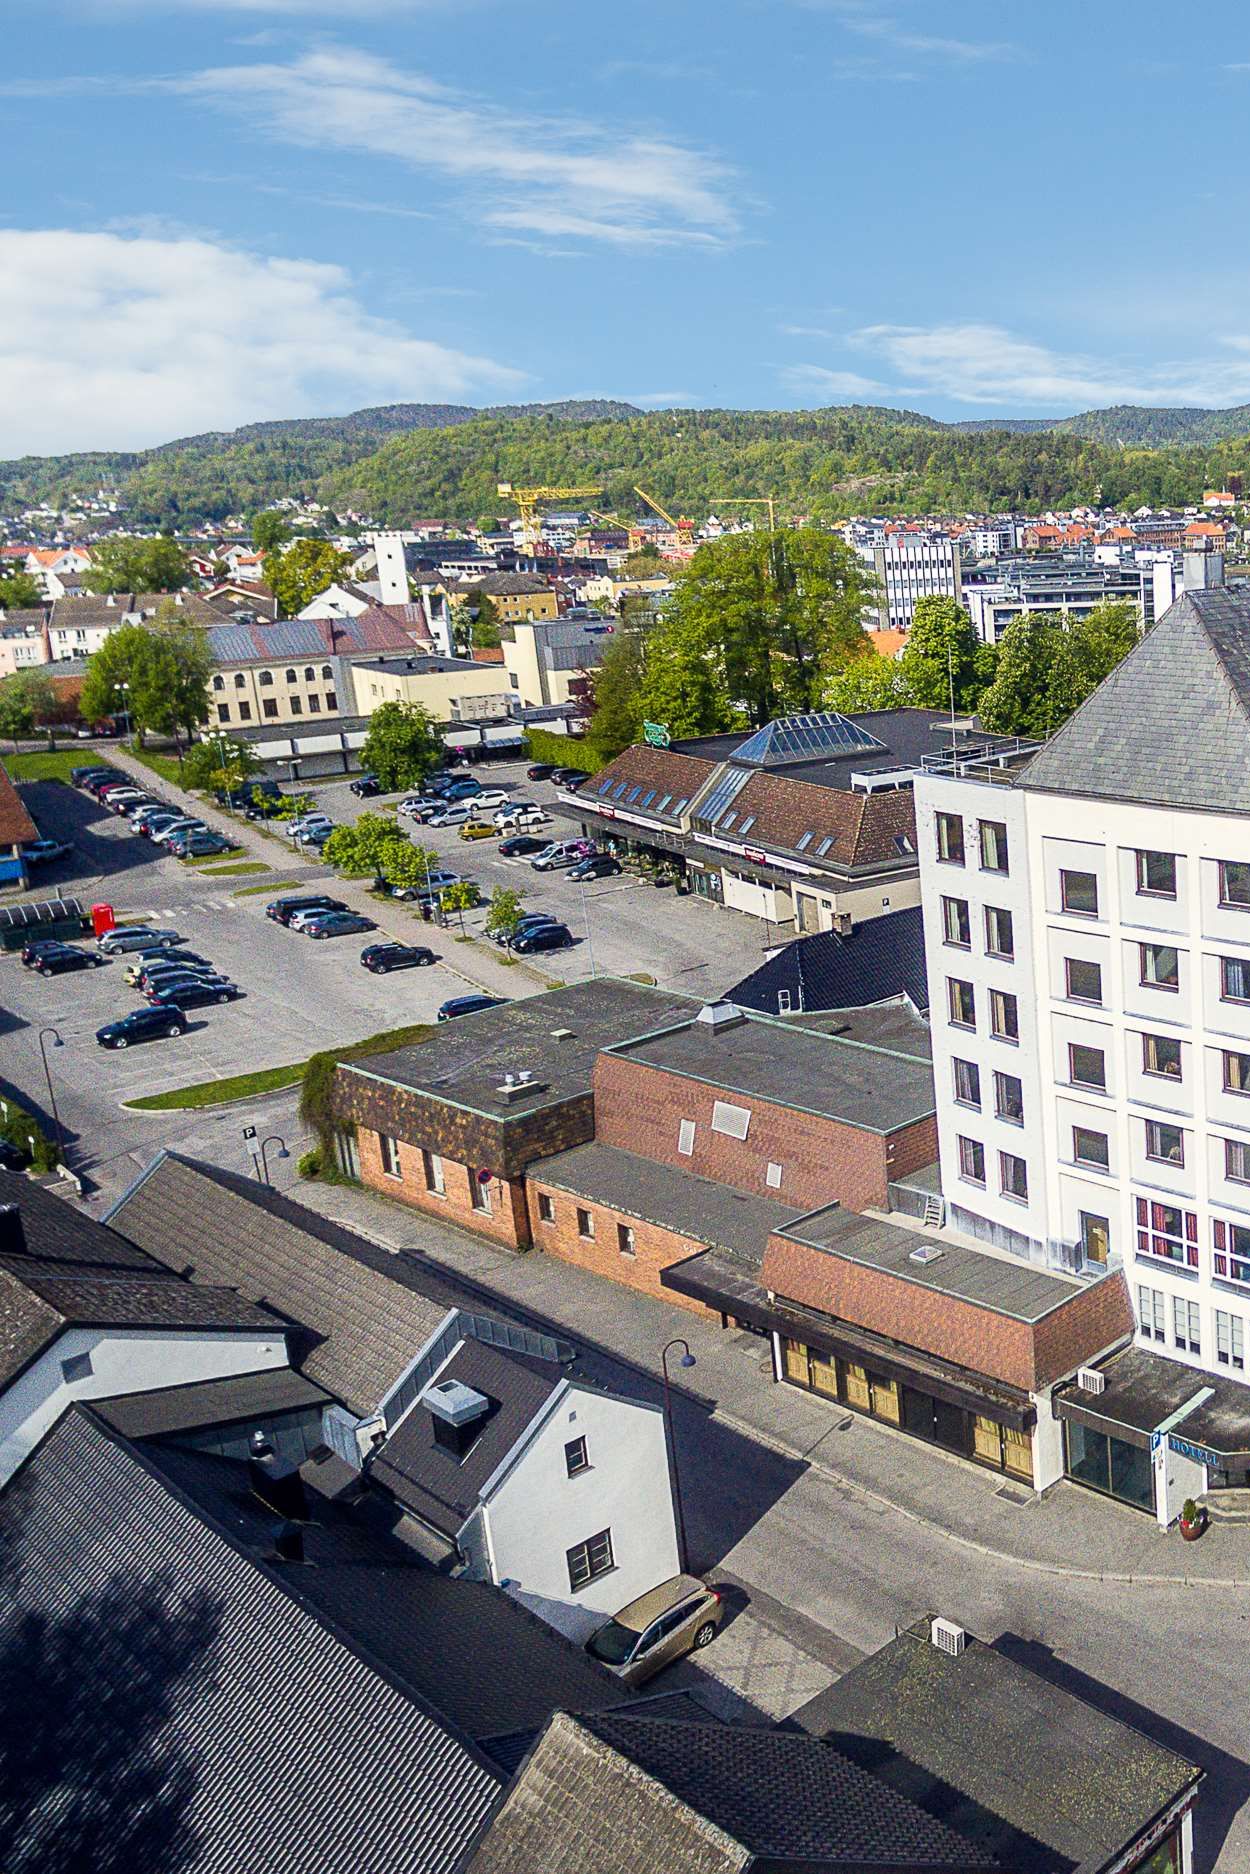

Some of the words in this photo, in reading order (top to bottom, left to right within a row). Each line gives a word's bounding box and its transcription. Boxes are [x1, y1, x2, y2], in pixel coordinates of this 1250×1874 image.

[246, 1129, 253, 1138] P
[1152, 1433, 1159, 1448] P
[1170, 1438, 1219, 1468] HOTELL
